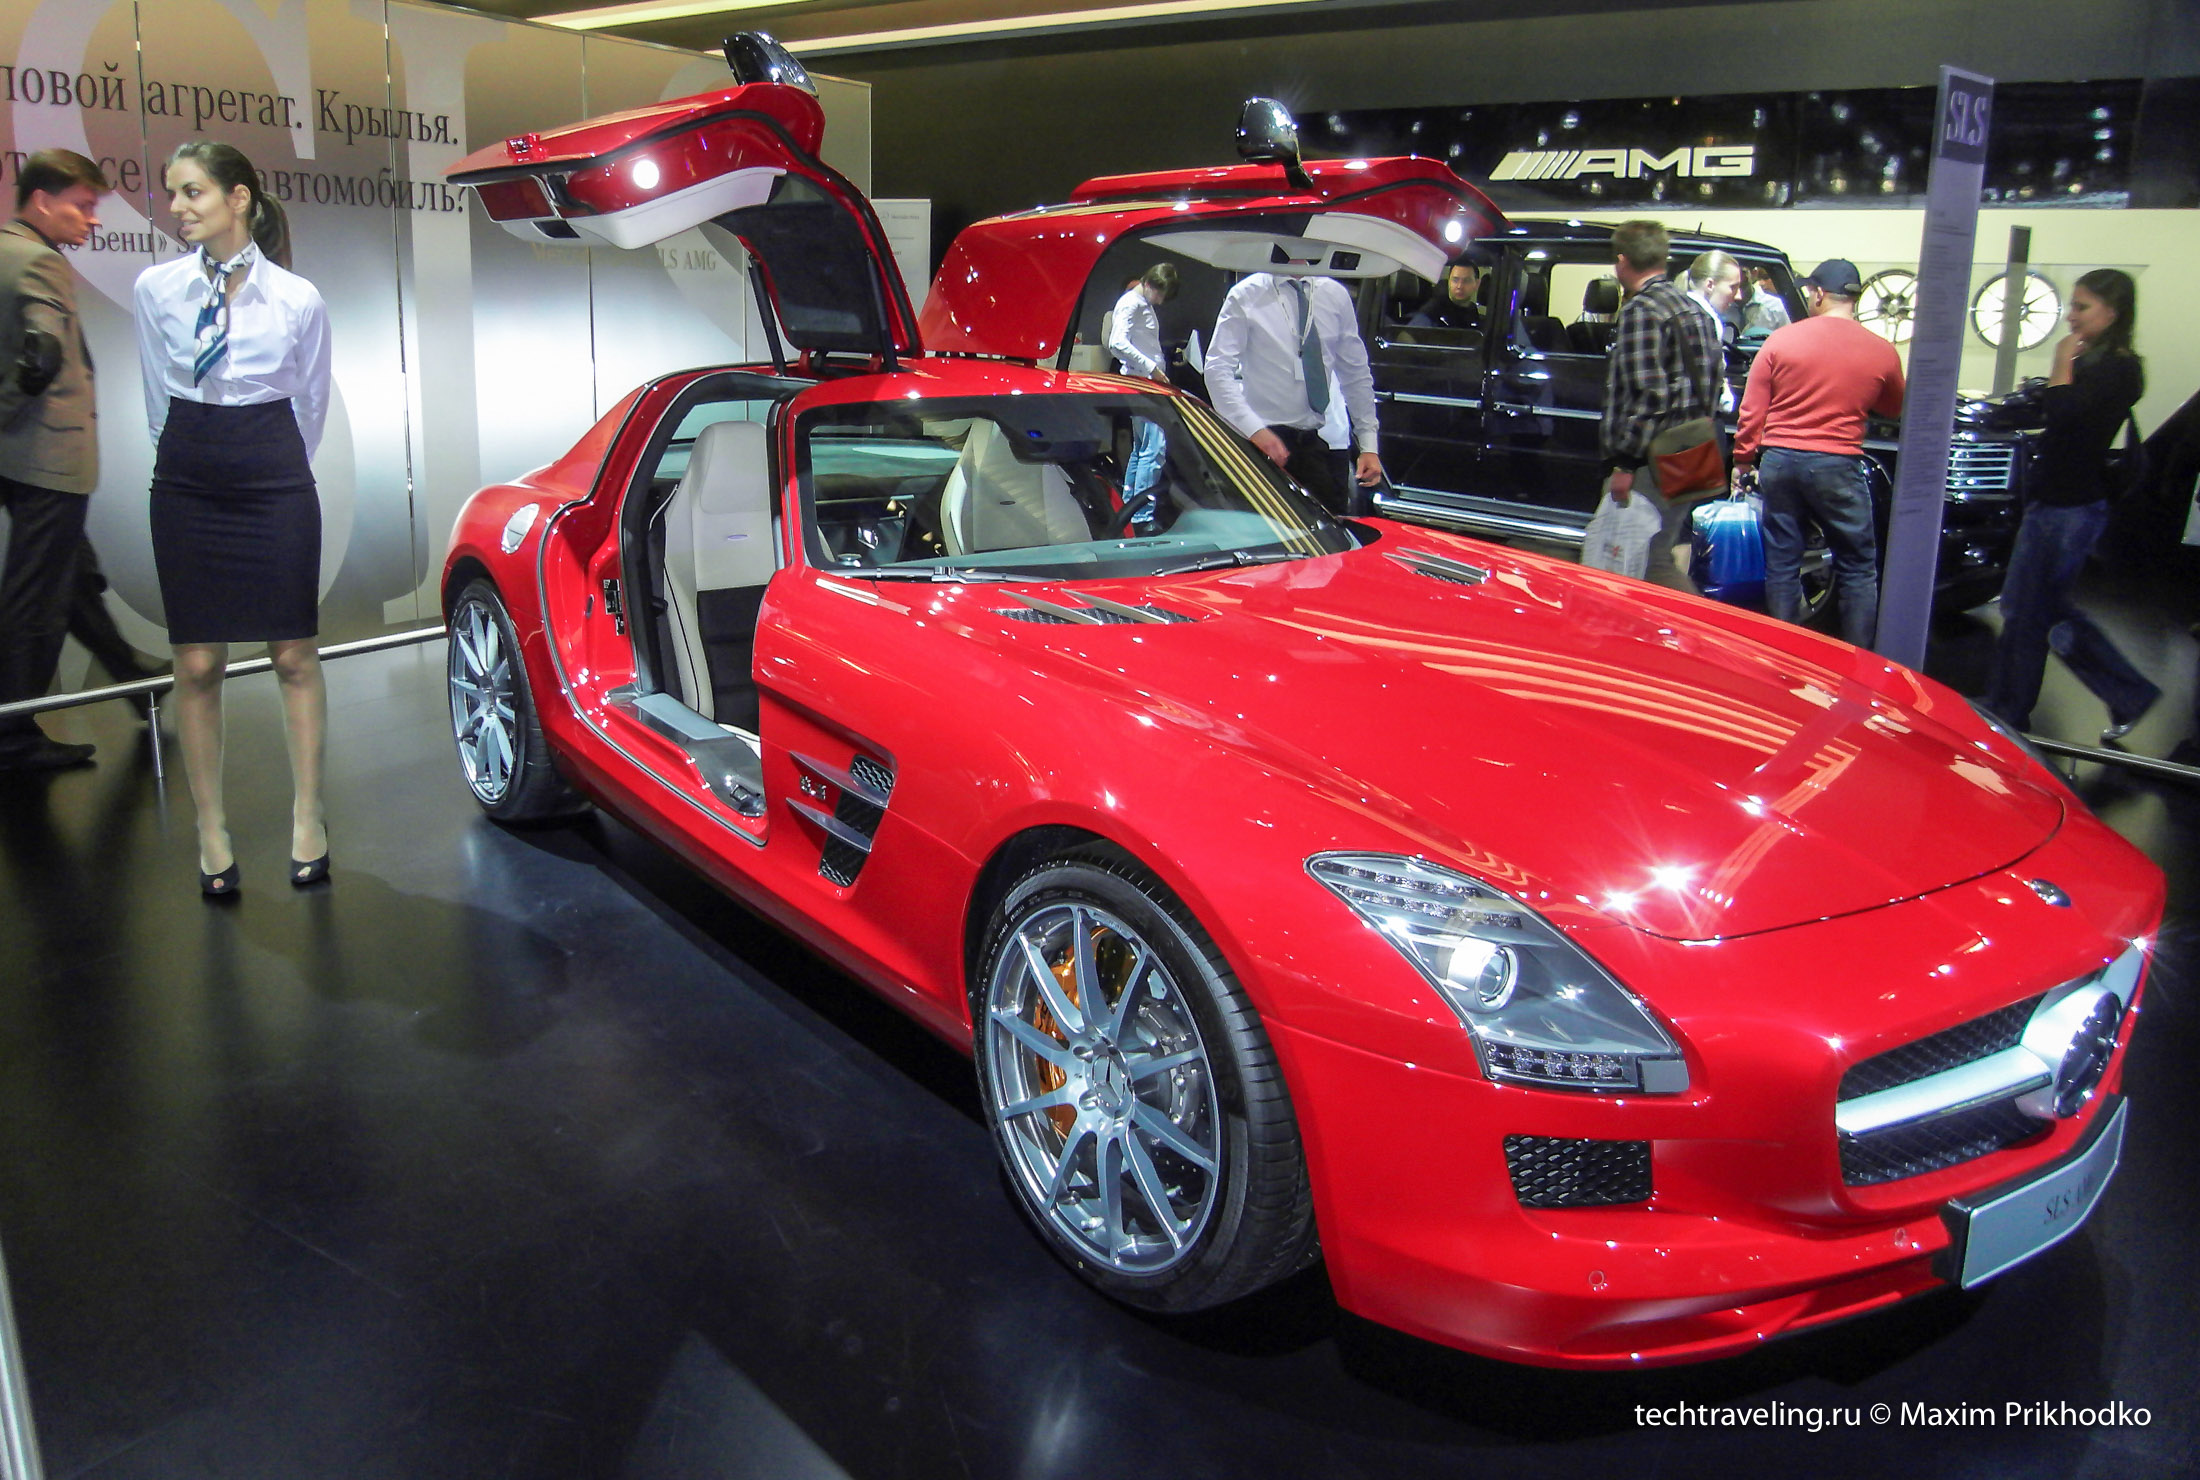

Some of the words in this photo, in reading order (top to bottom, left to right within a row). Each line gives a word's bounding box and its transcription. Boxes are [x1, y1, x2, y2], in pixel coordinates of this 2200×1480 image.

[147, 81, 303, 131] агрегат.
[316, 88, 458, 146] Крылья.
[1946, 90, 1988, 146] SLS
[1563, 146, 1755, 179] AMG
